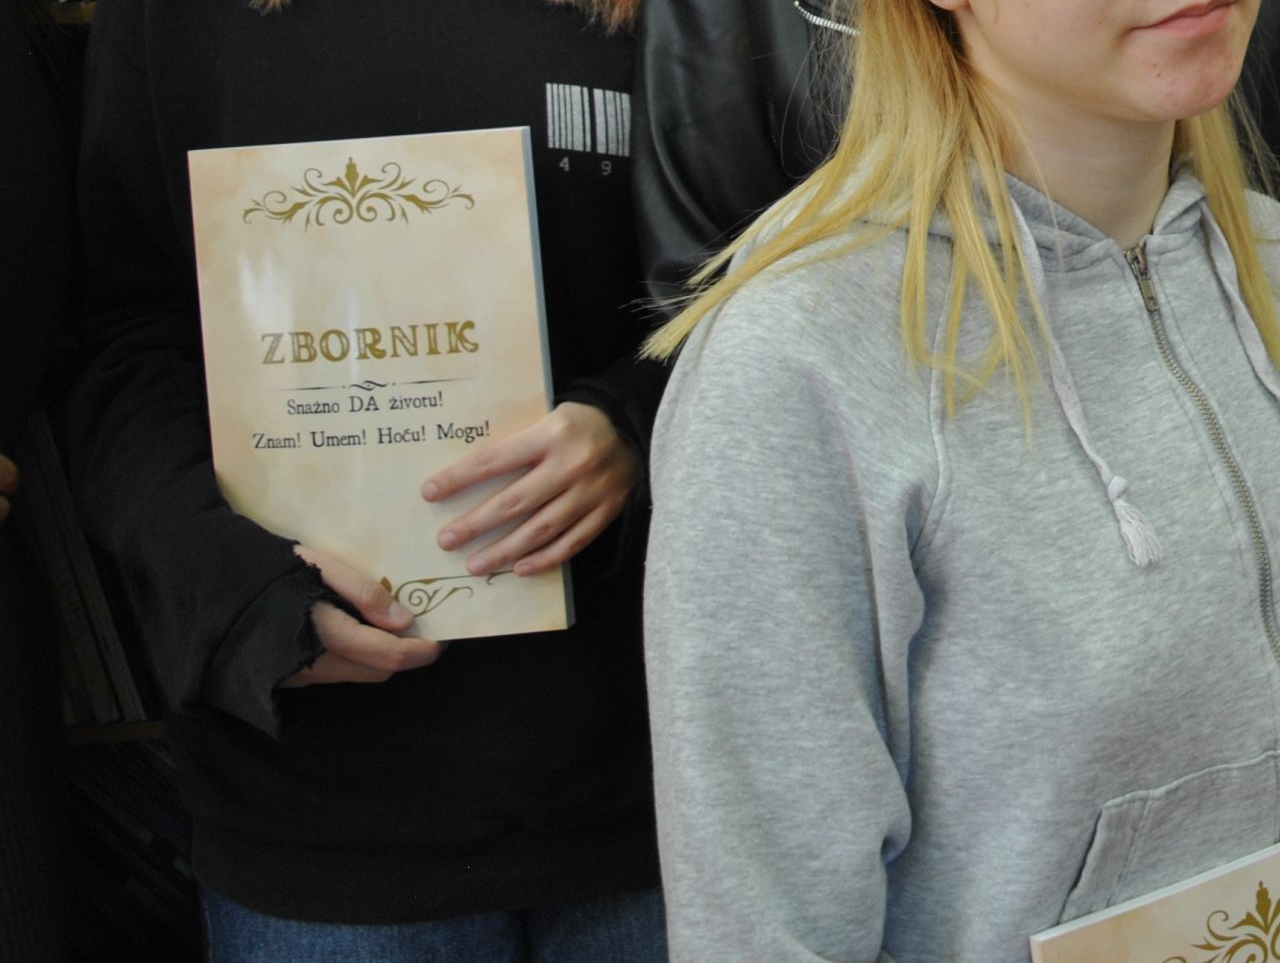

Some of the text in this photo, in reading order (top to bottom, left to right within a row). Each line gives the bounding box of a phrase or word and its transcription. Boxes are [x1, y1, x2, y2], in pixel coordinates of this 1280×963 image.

[559, 156, 612, 176] 4 9
[261, 320, 480, 365] ZBORNIK
[348, 395, 380, 413] DA
[253, 421, 491, 449] Znam! Umem! Hoću! Mogu!
